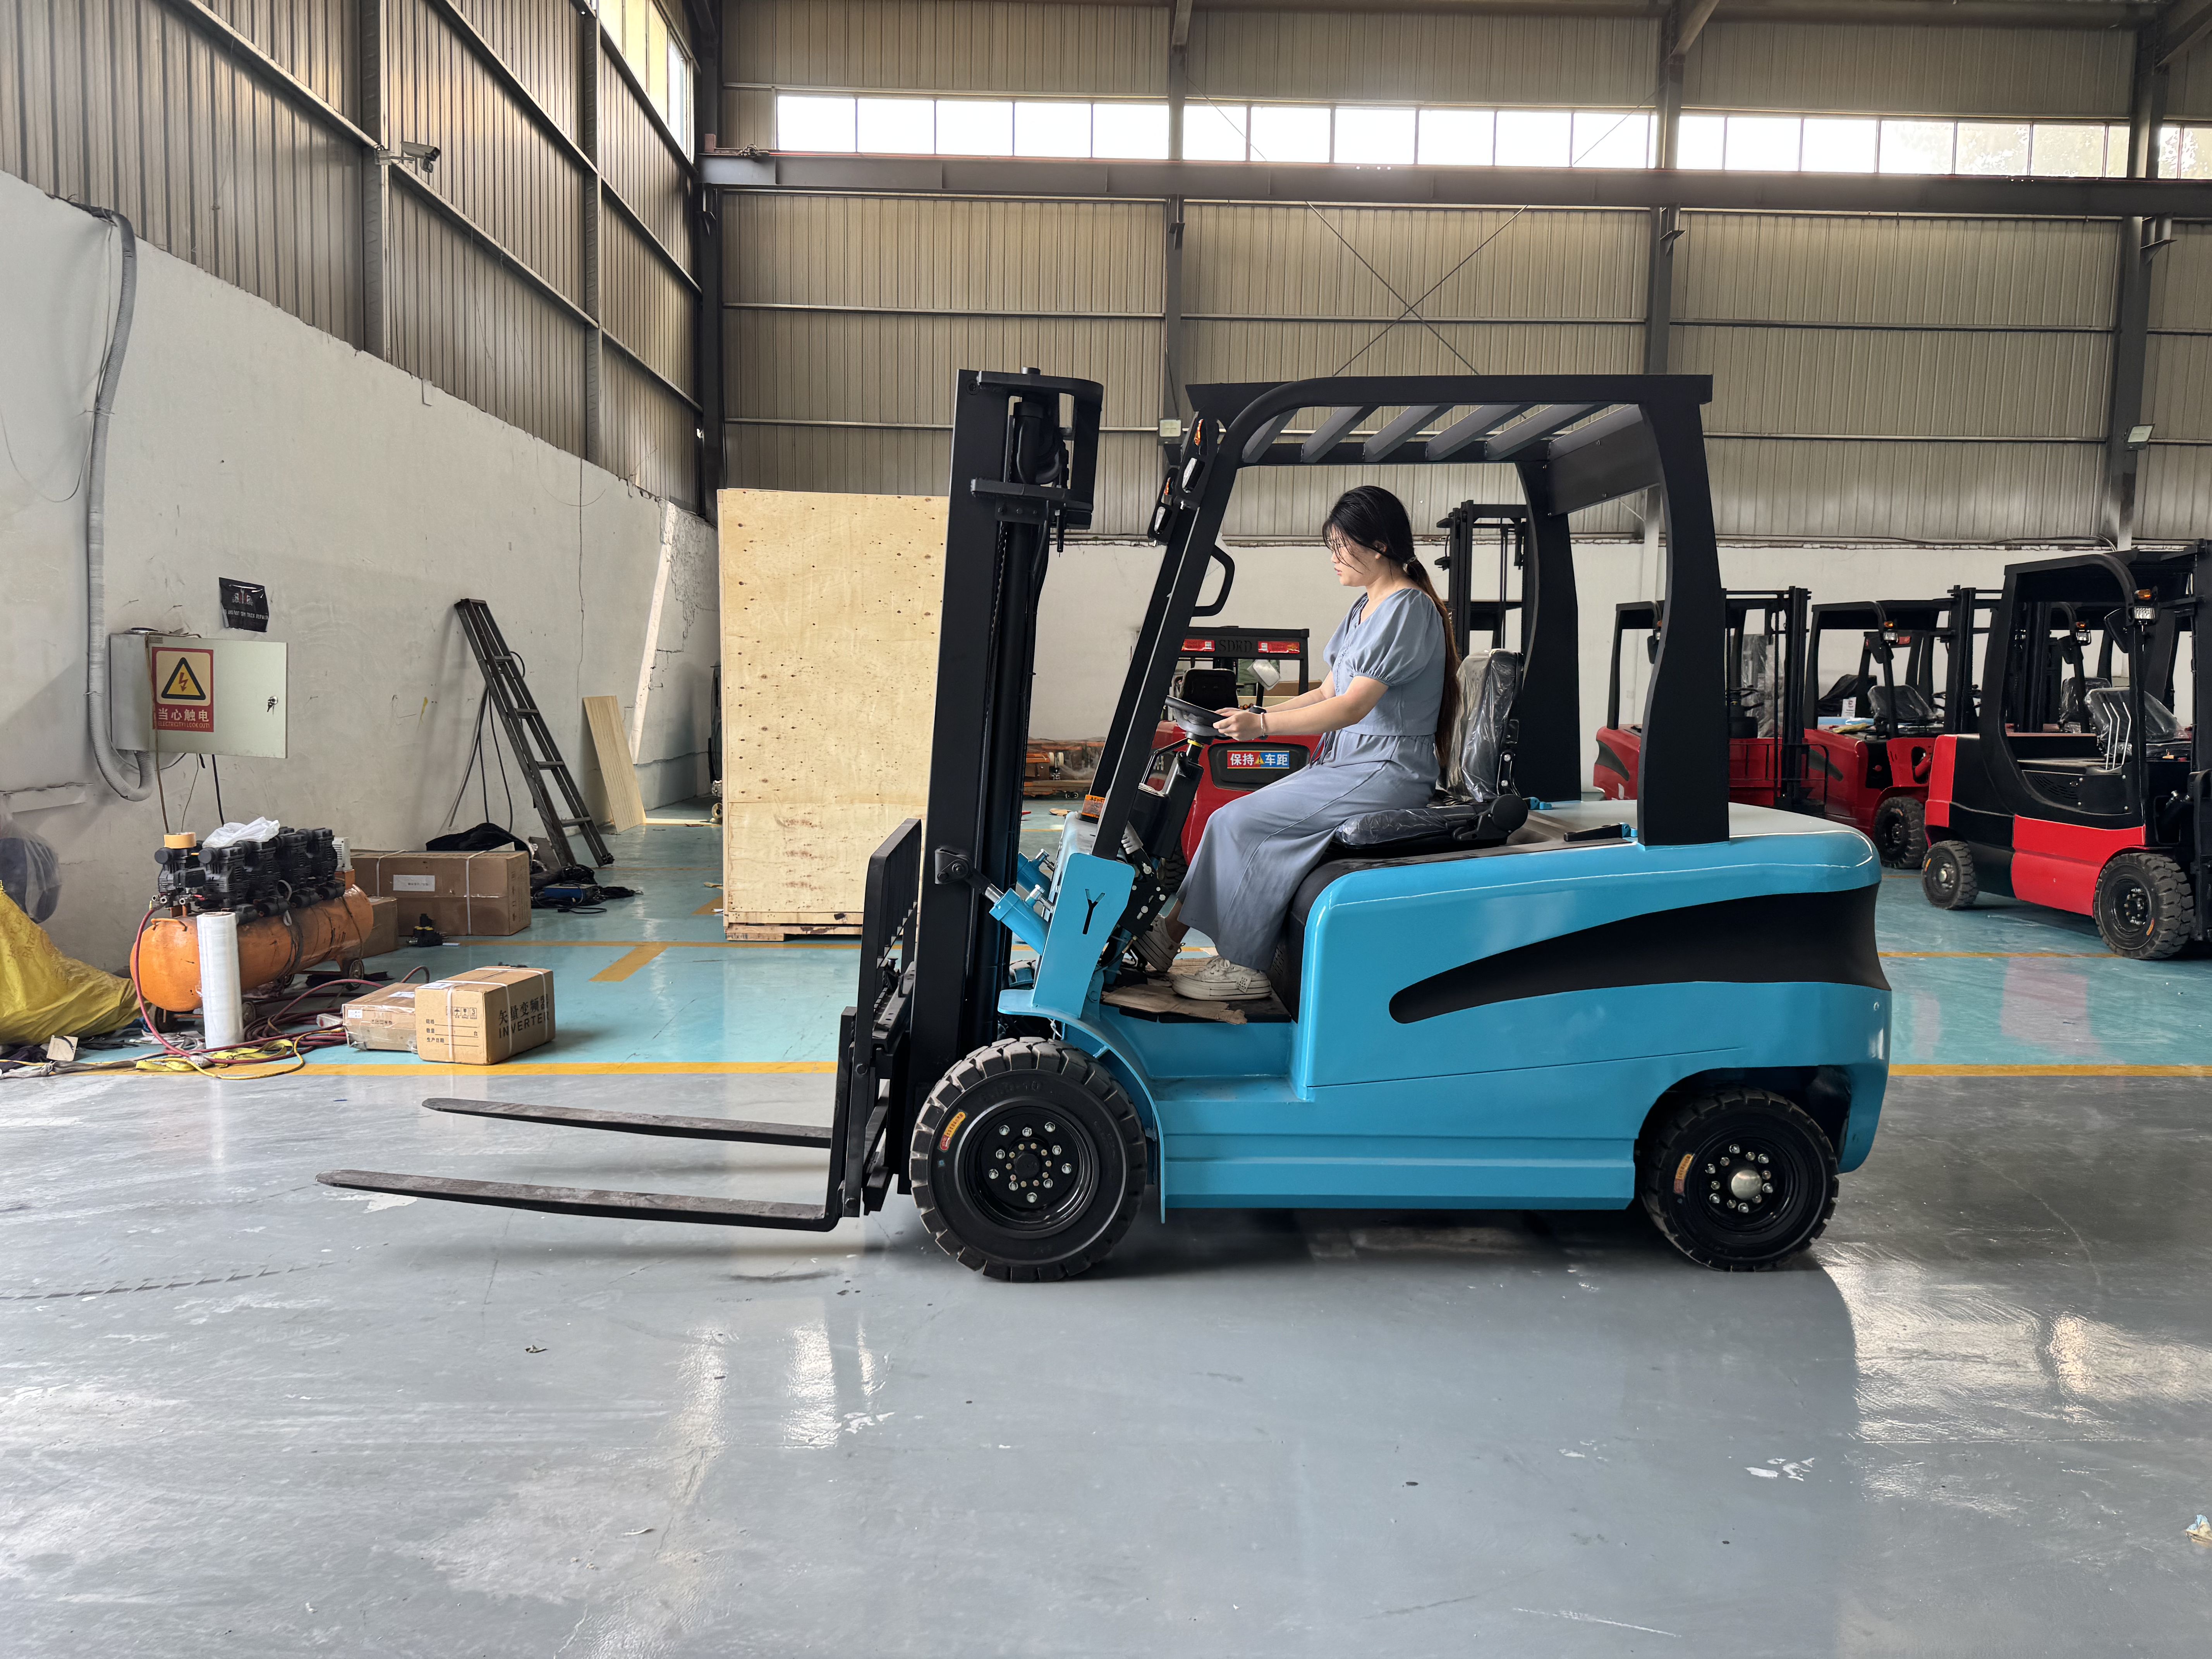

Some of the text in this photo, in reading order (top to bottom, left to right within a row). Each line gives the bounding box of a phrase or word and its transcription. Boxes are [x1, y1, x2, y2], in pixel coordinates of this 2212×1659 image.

[158, 708, 209, 722] 当心触电
[1230, 753, 1288, 766] 保持 车距
[499, 1012, 549, 1039] INVERTER
